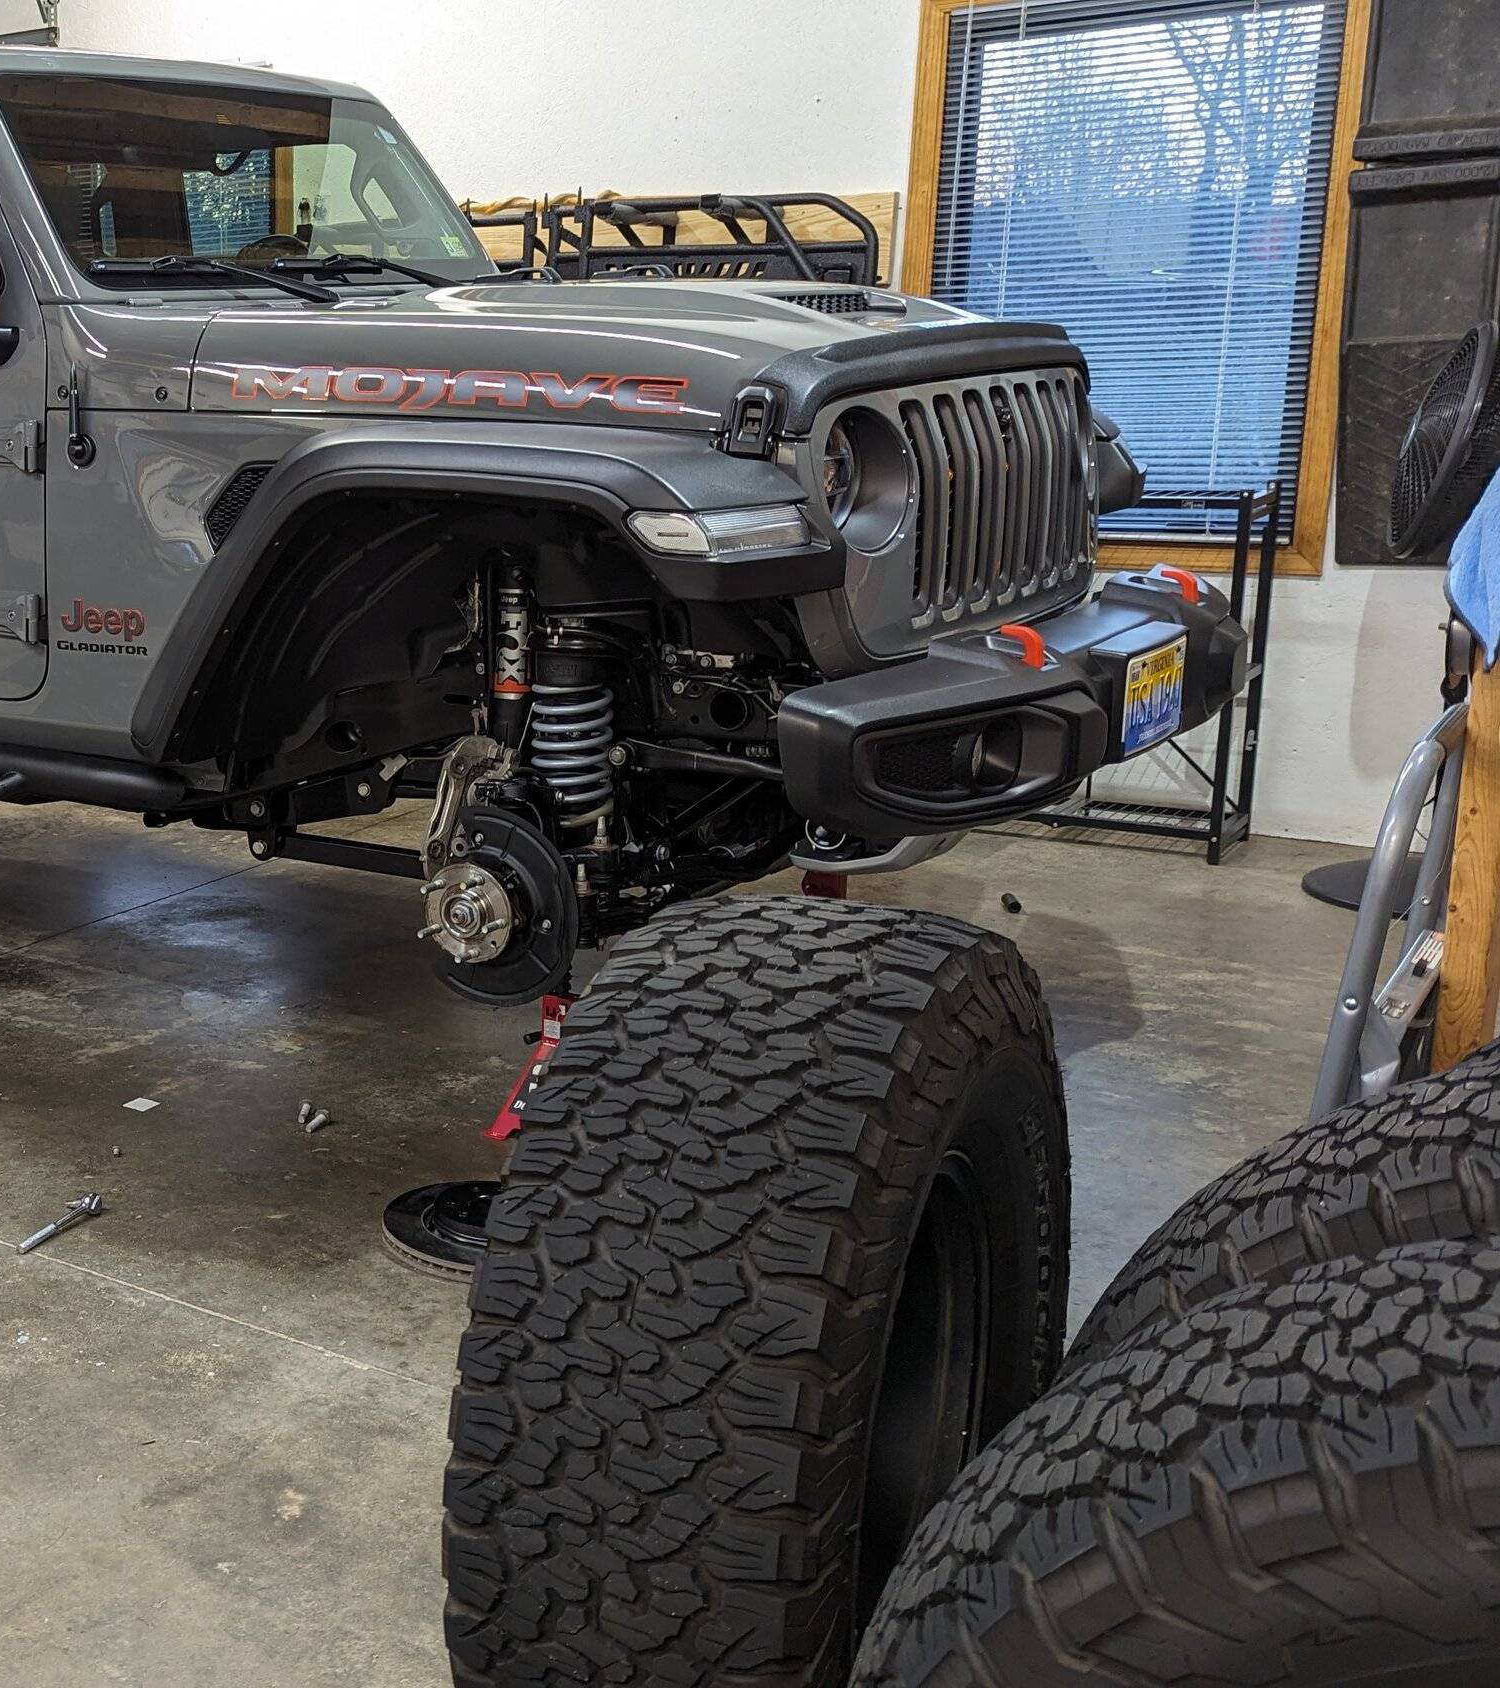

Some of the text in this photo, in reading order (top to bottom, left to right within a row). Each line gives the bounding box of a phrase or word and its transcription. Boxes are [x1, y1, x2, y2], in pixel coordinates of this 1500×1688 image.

[231, 366, 689, 414] MOJAVE
[60, 597, 146, 642] Jeep
[57, 640, 148, 656] GLADIATOR
[1130, 679, 1154, 728] USA
